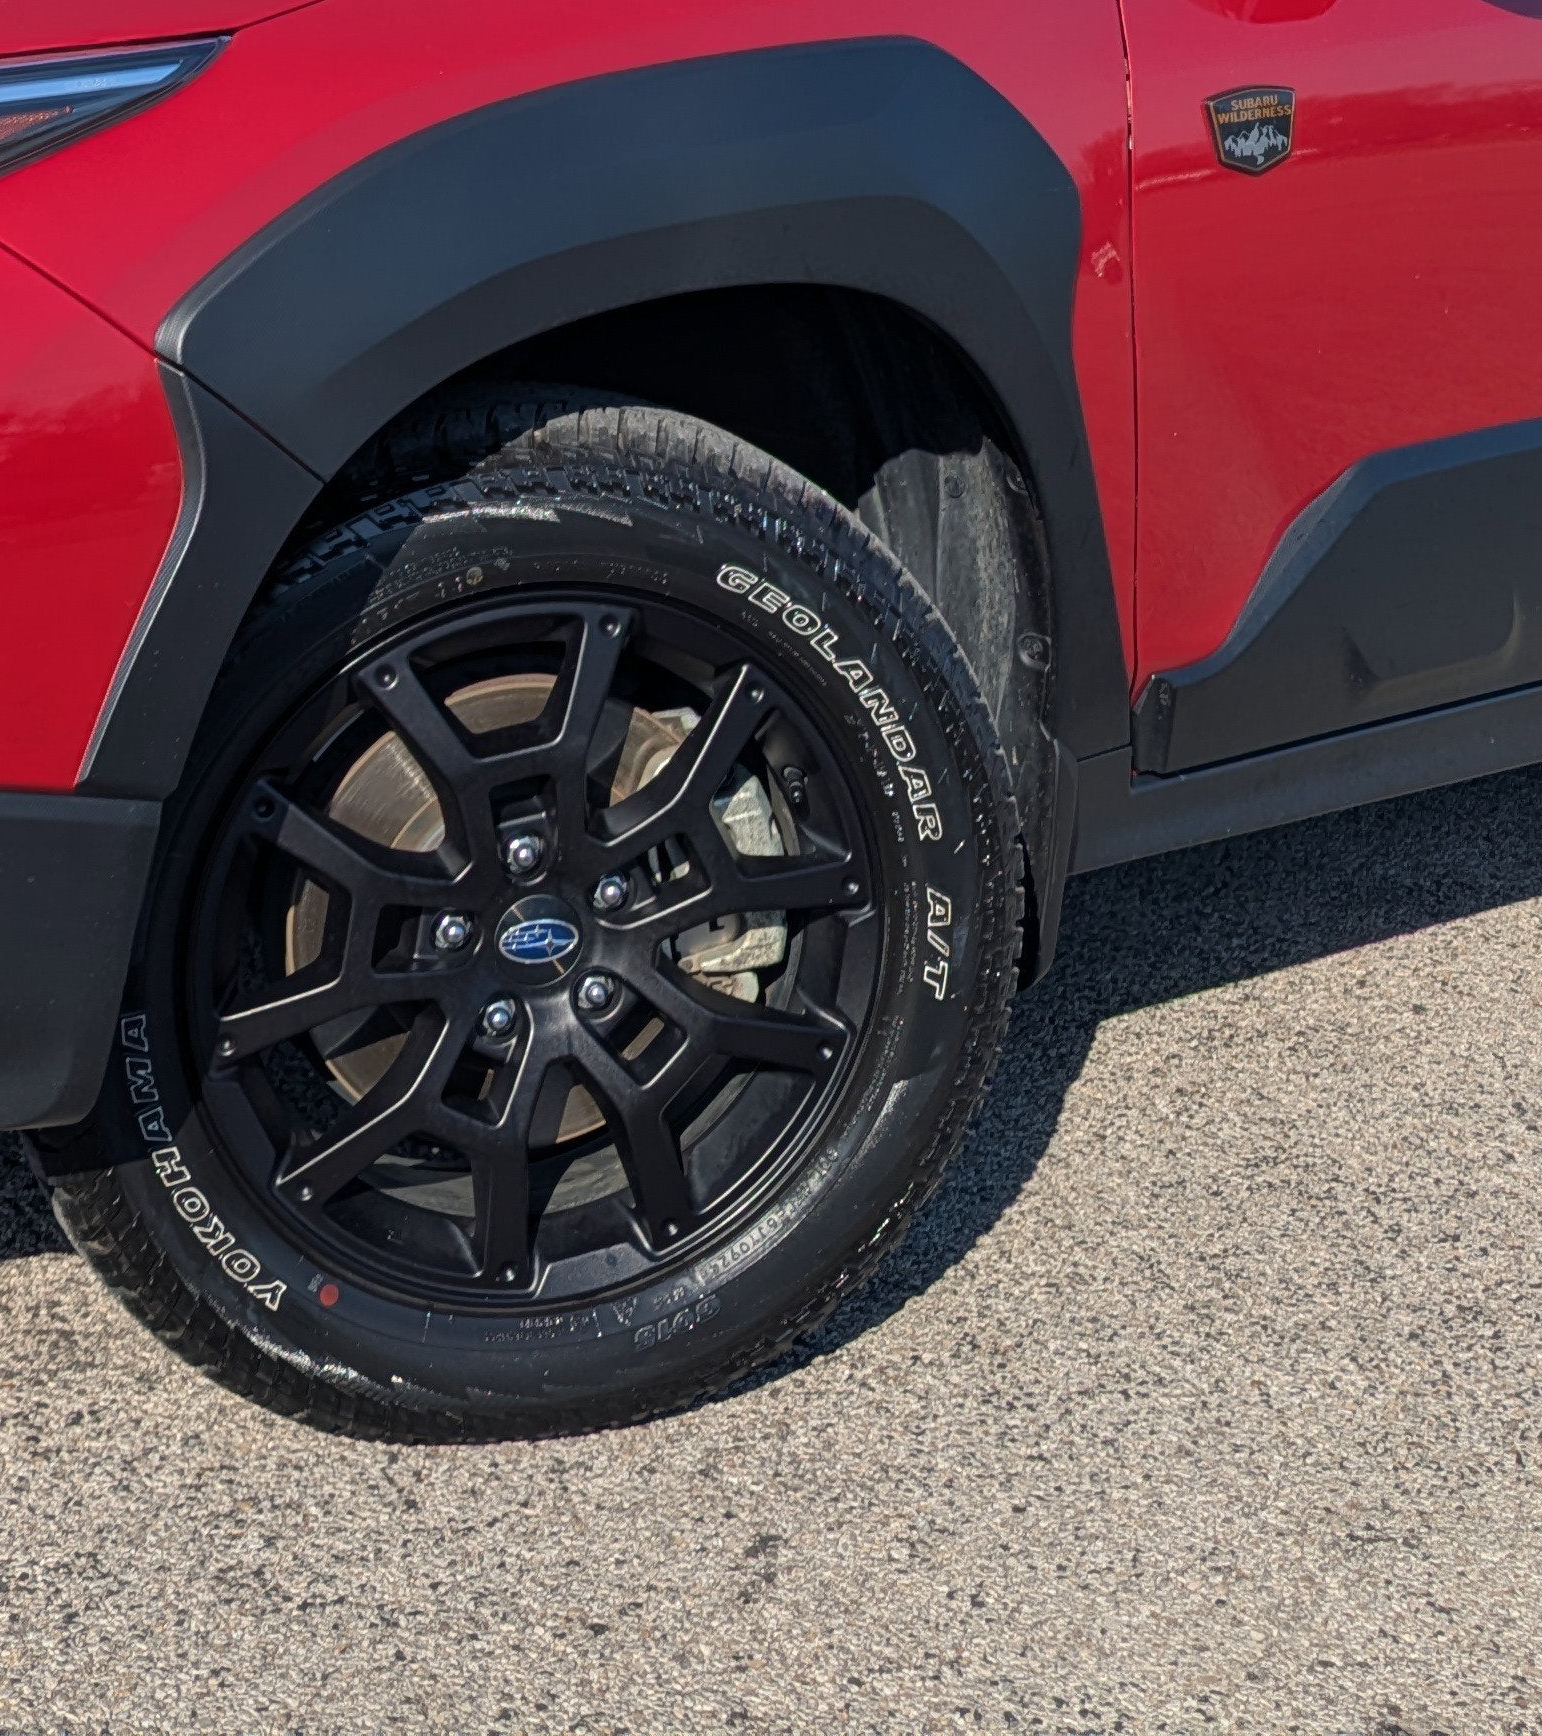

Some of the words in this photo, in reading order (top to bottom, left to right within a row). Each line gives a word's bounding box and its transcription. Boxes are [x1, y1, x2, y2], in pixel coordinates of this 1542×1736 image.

[1217, 104, 1291, 124] WILDERNESS
[1230, 94, 1278, 110] SUBARU
[716, 564, 944, 842] GEOLANDAR
[922, 886, 952, 1000] A/T
[121, 1013, 288, 1311] YOKOHAMA
